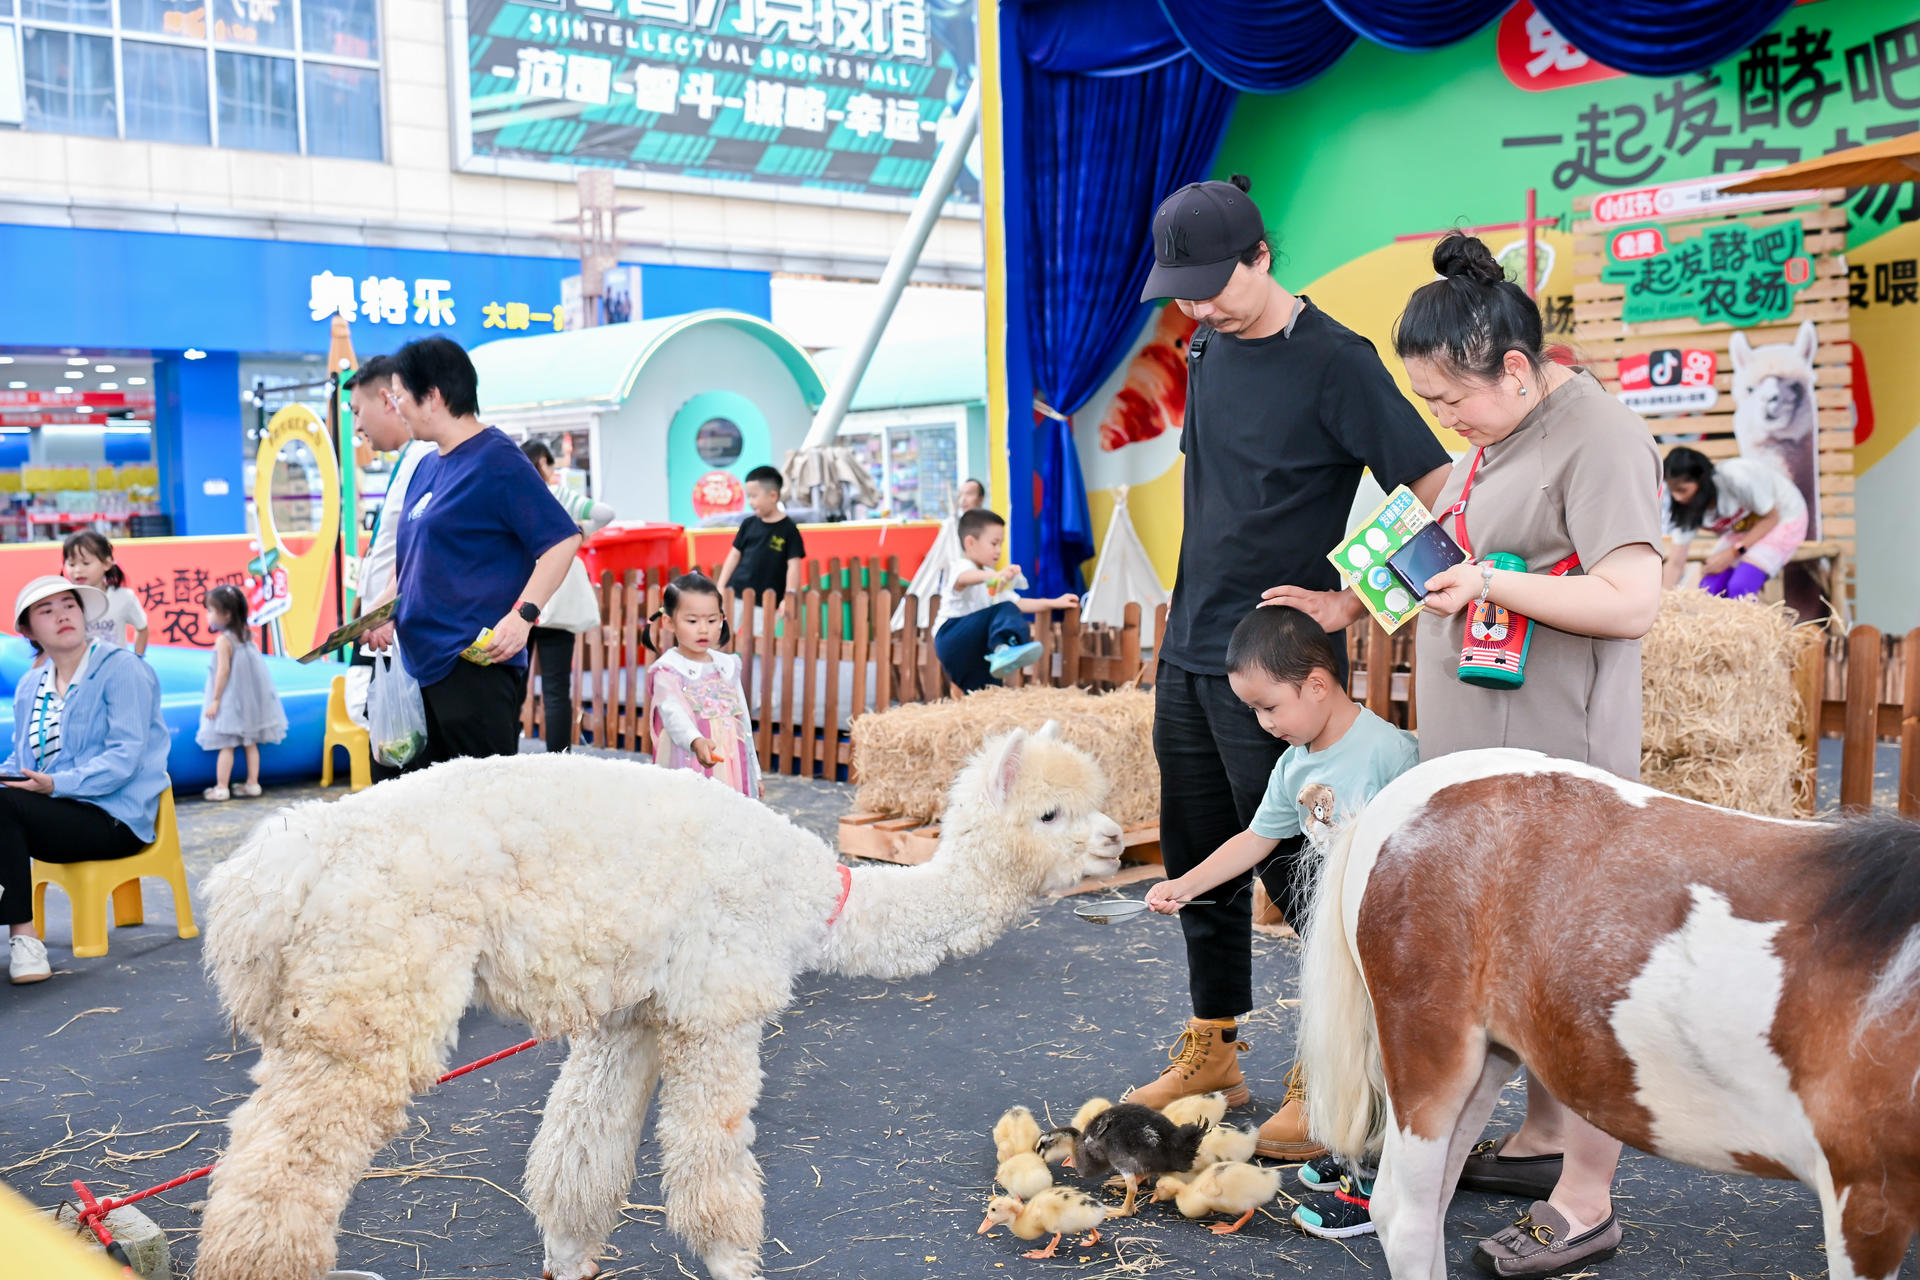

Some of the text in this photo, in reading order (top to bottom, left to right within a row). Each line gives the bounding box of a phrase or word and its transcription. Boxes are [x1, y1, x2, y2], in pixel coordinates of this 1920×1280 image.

[760, 49, 851, 80] SPORTS
[856, 61, 911, 87] HALL
[309, 270, 456, 327] 奥特乐
[1698, 270, 1788, 319] 农场
